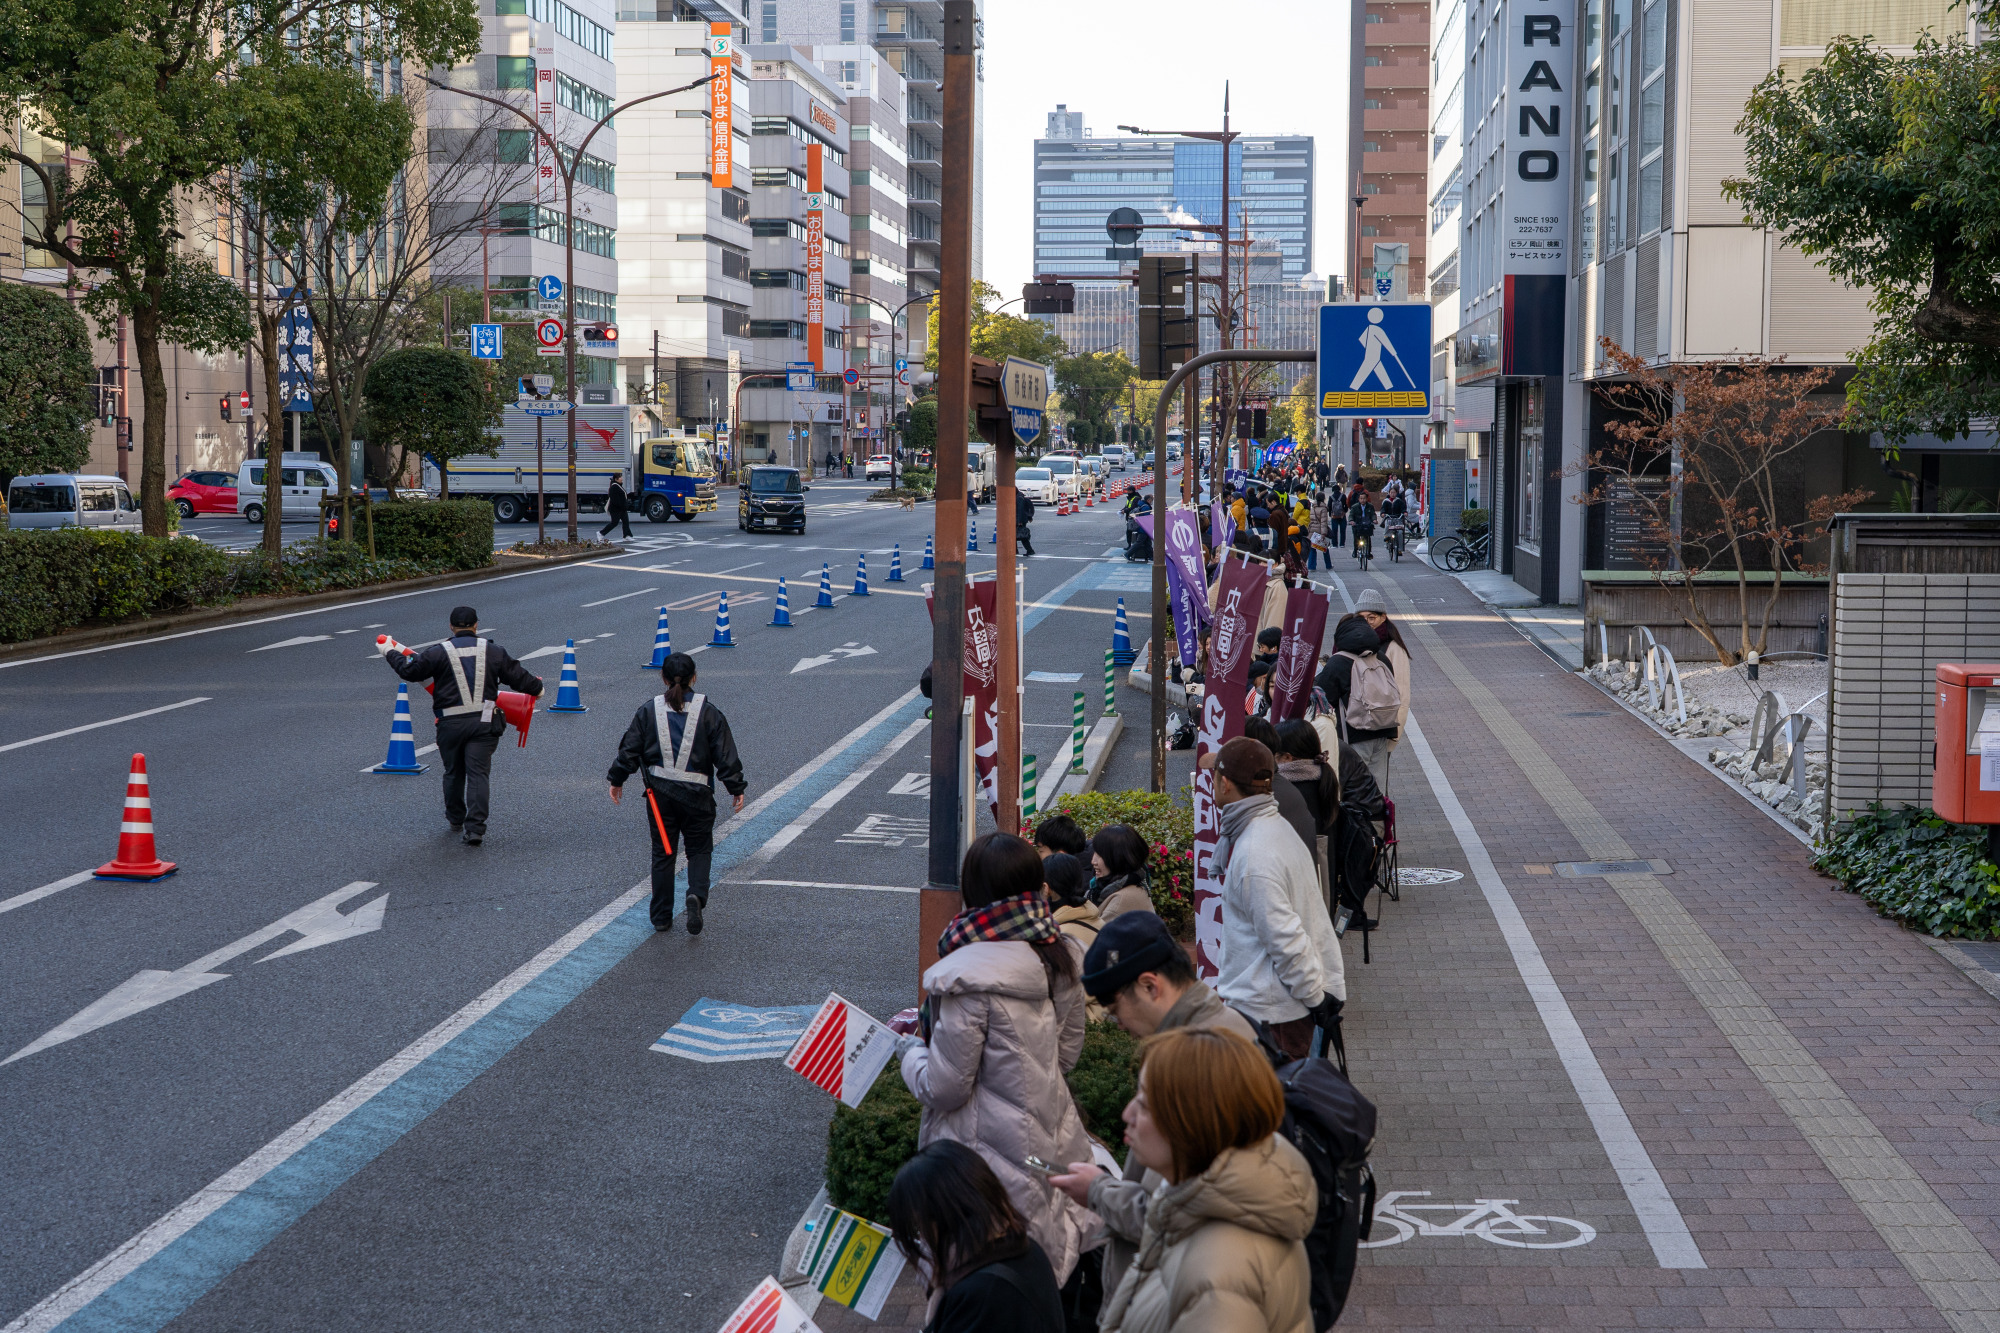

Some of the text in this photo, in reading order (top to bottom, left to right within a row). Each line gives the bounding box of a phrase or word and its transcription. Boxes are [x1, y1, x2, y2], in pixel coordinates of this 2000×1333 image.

[714, 64, 729, 175] おかやま信用金庫
[808, 215, 822, 324] おかやま信用金庫
[1513, 216, 1559, 224] SINCE 1930
